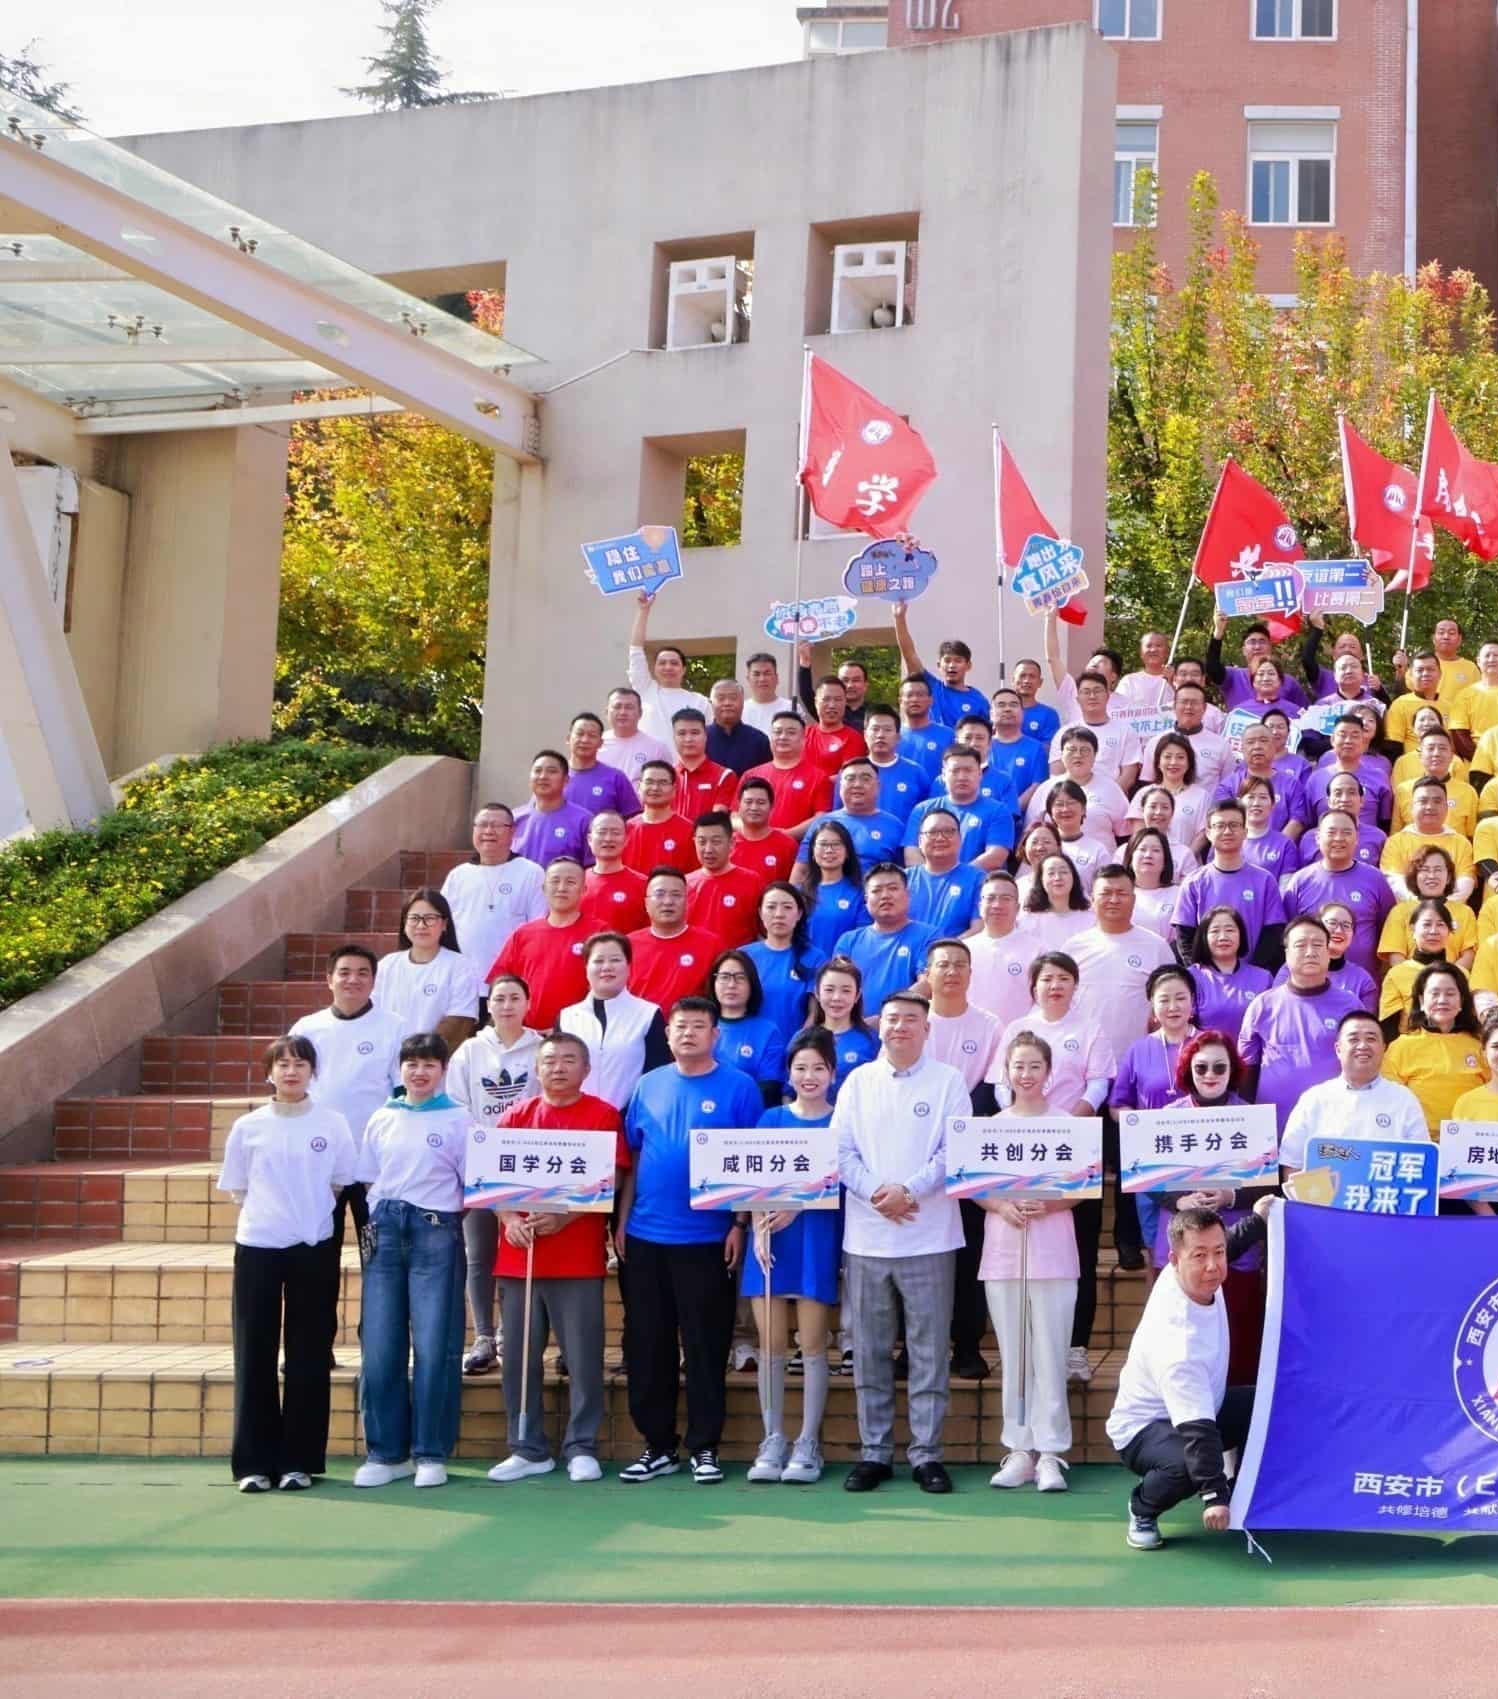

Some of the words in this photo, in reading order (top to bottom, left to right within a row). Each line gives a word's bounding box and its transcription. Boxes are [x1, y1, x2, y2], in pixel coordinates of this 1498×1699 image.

[1314, 591, 1376, 607] 比赛第二
[981, 1143, 1073, 1161] 共创分会
[1154, 1131, 1248, 1153] 携手分会
[499, 1153, 588, 1175] 国学分会
[722, 1154, 811, 1174] 咸阳分会
[1368, 1151, 1425, 1183] 冠军
[1344, 1184, 1428, 1215] 我来了
